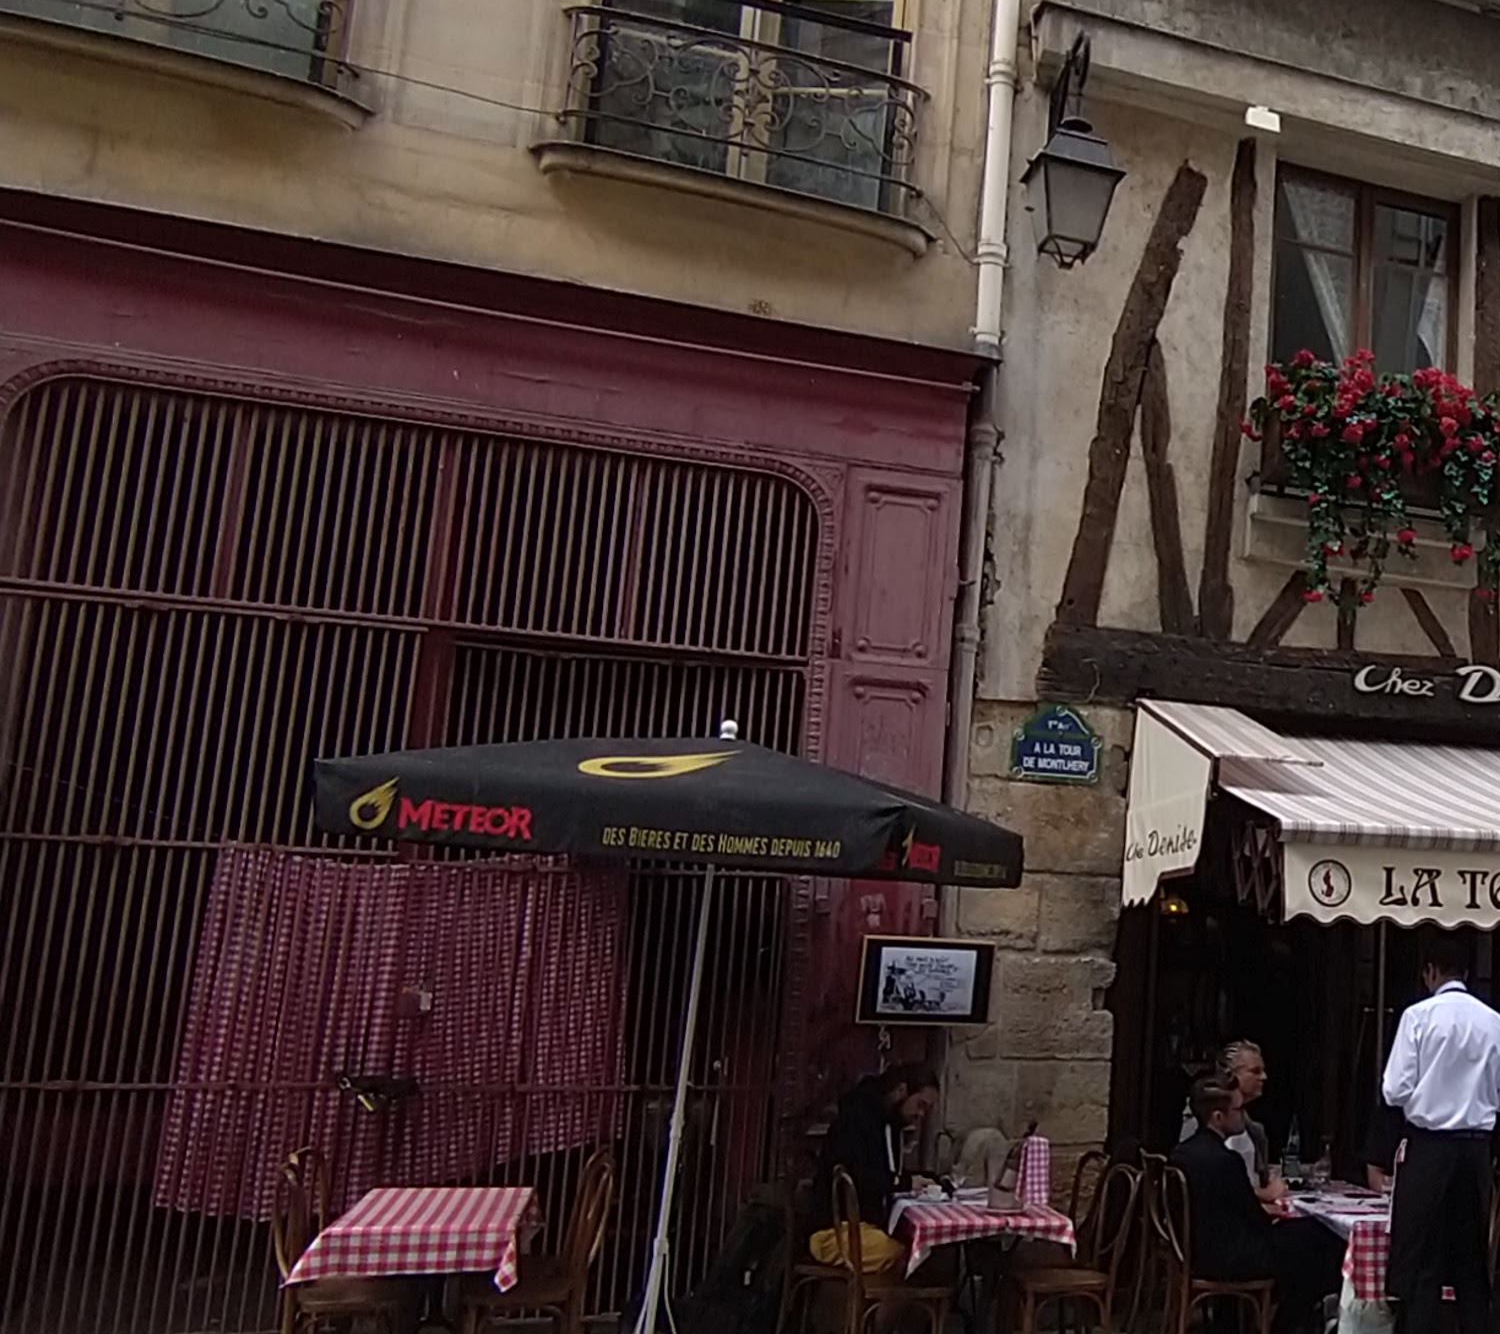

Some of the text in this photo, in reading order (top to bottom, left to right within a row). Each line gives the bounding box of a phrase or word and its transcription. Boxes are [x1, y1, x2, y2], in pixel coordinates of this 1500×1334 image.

[1353, 664, 1435, 697] Chez
[1022, 756, 1090, 772] DE MONTLHERY
[1033, 742, 1082, 757] A LA TOUR
[397, 797, 533, 841] METEOR
[602, 826, 626, 846] DES
[673, 831, 689, 850] ET
[691, 833, 715, 853] DES
[718, 833, 768, 856] HOMMES
[770, 837, 812, 858] DEPUIS
[814, 840, 842, 859] 1640
[1378, 866, 1445, 908] LA
